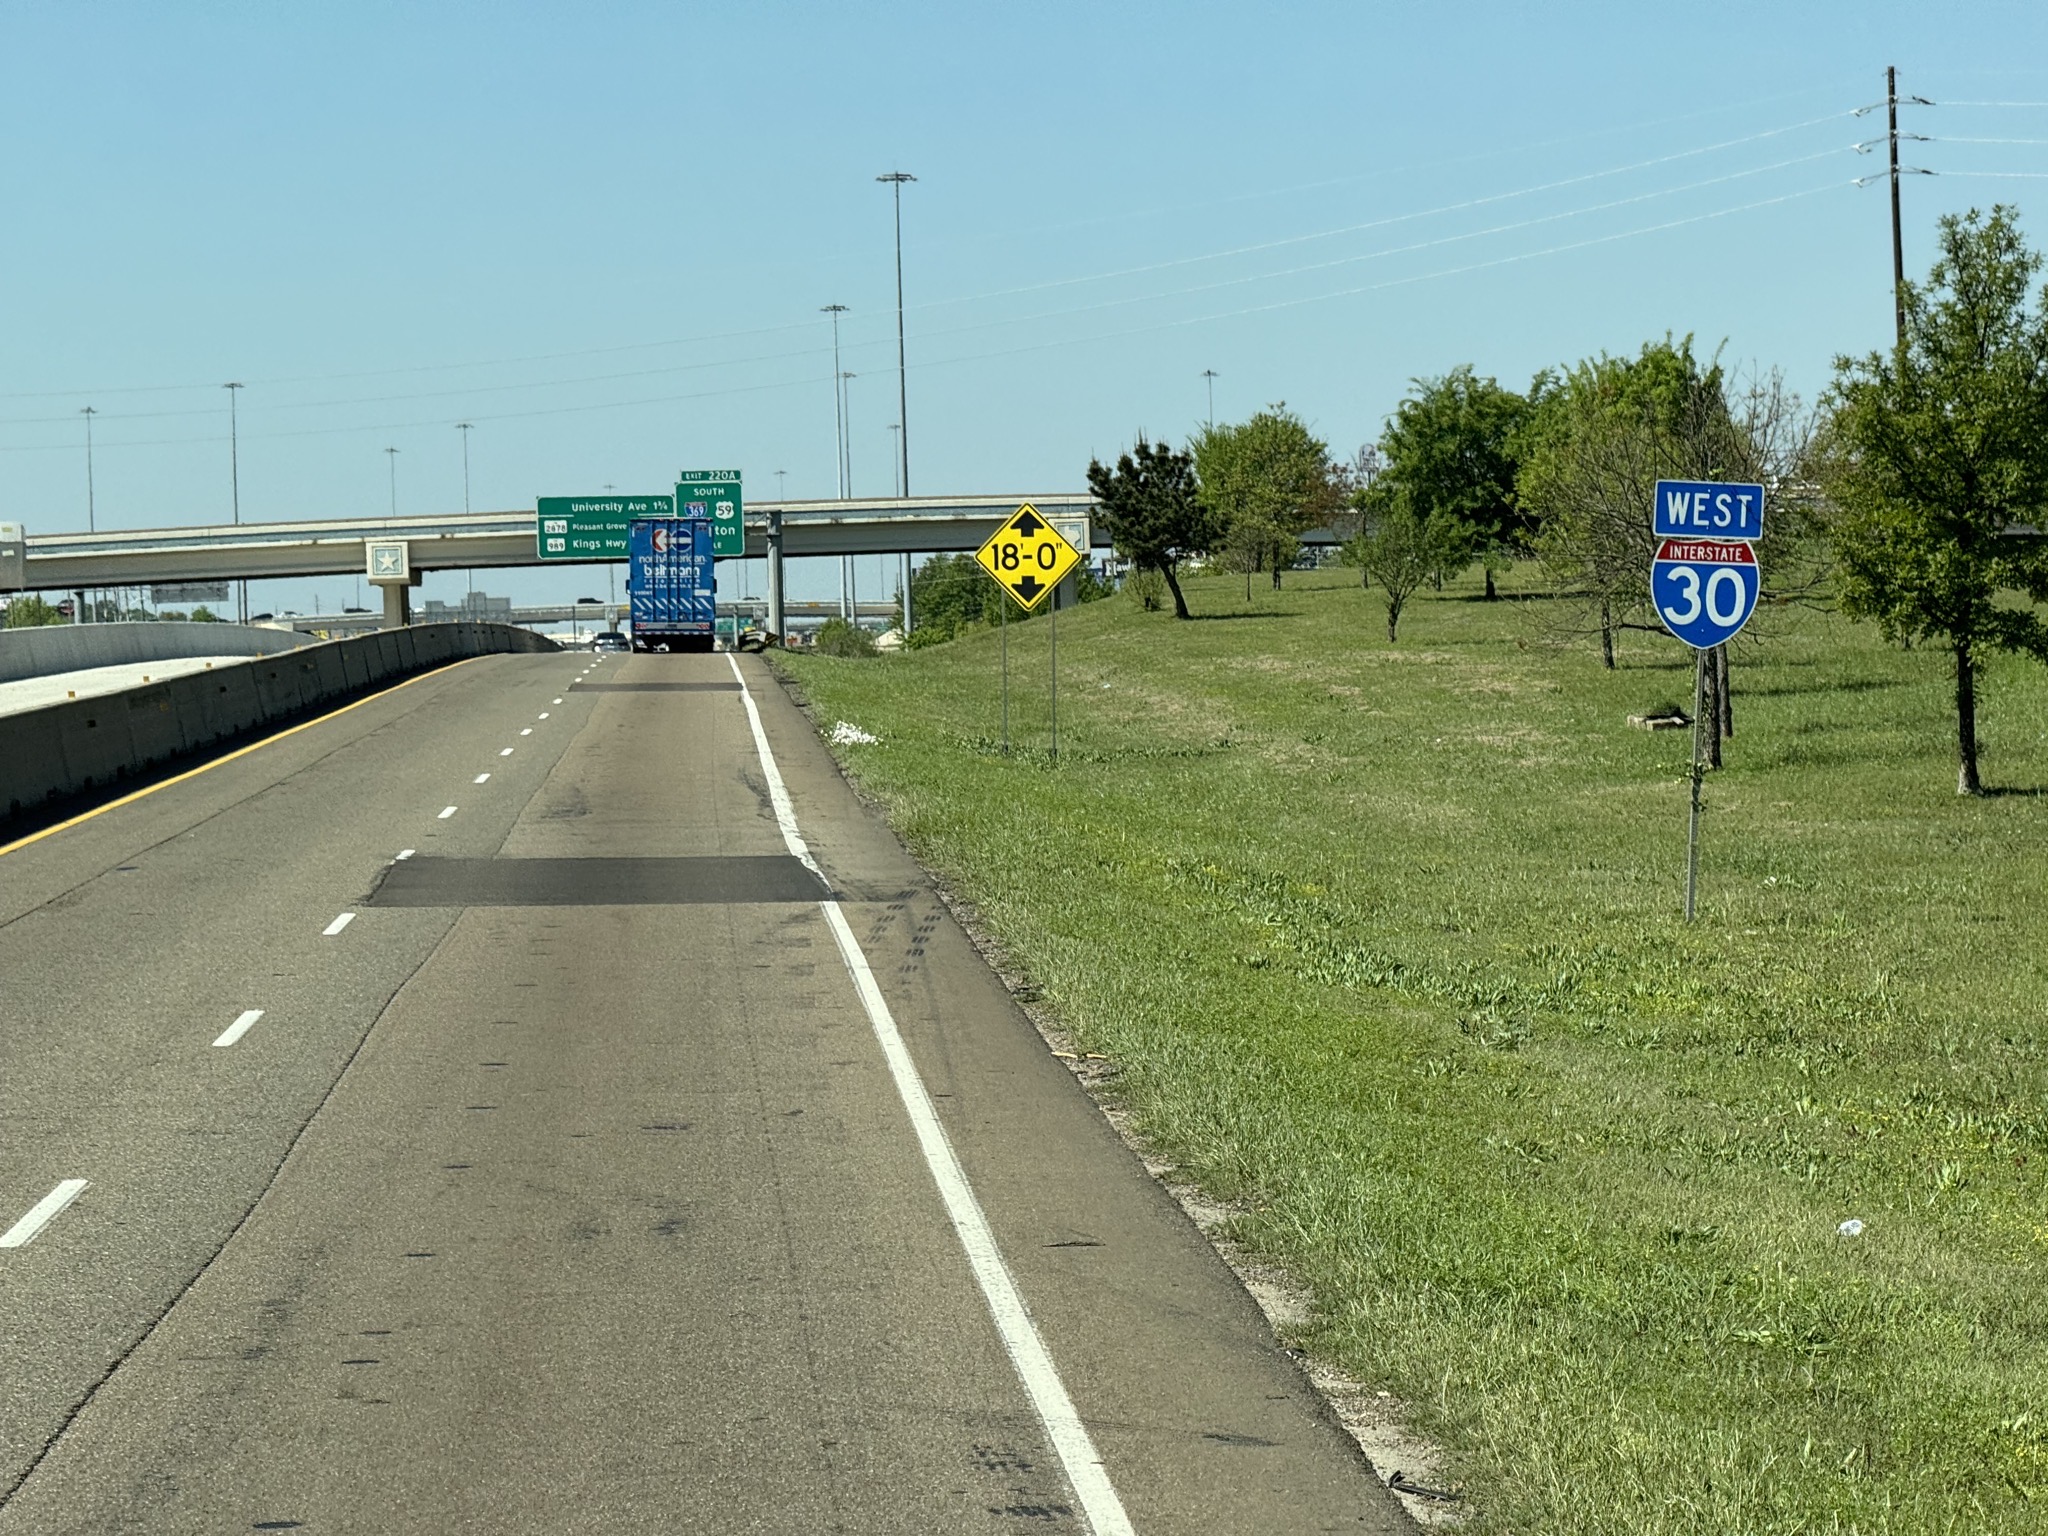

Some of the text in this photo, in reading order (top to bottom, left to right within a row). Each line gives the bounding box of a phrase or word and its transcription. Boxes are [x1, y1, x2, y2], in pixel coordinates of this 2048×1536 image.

[685, 471, 736, 480] EXIT 220A
[693, 487, 725, 496] SOUTH
[571, 502, 623, 513] University
[628, 502, 647, 511] Ave
[688, 506, 704, 517] 369
[717, 505, 732, 516] 59
[1667, 491, 1752, 528] WEST
[546, 524, 566, 532] 2878
[572, 522, 627, 531] Pleasant Grove
[548, 542, 564, 550] 989
[572, 539, 627, 550] Kings Hwy
[1669, 545, 1743, 562] INTERSTATE
[1663, 566, 1746, 627] 30
